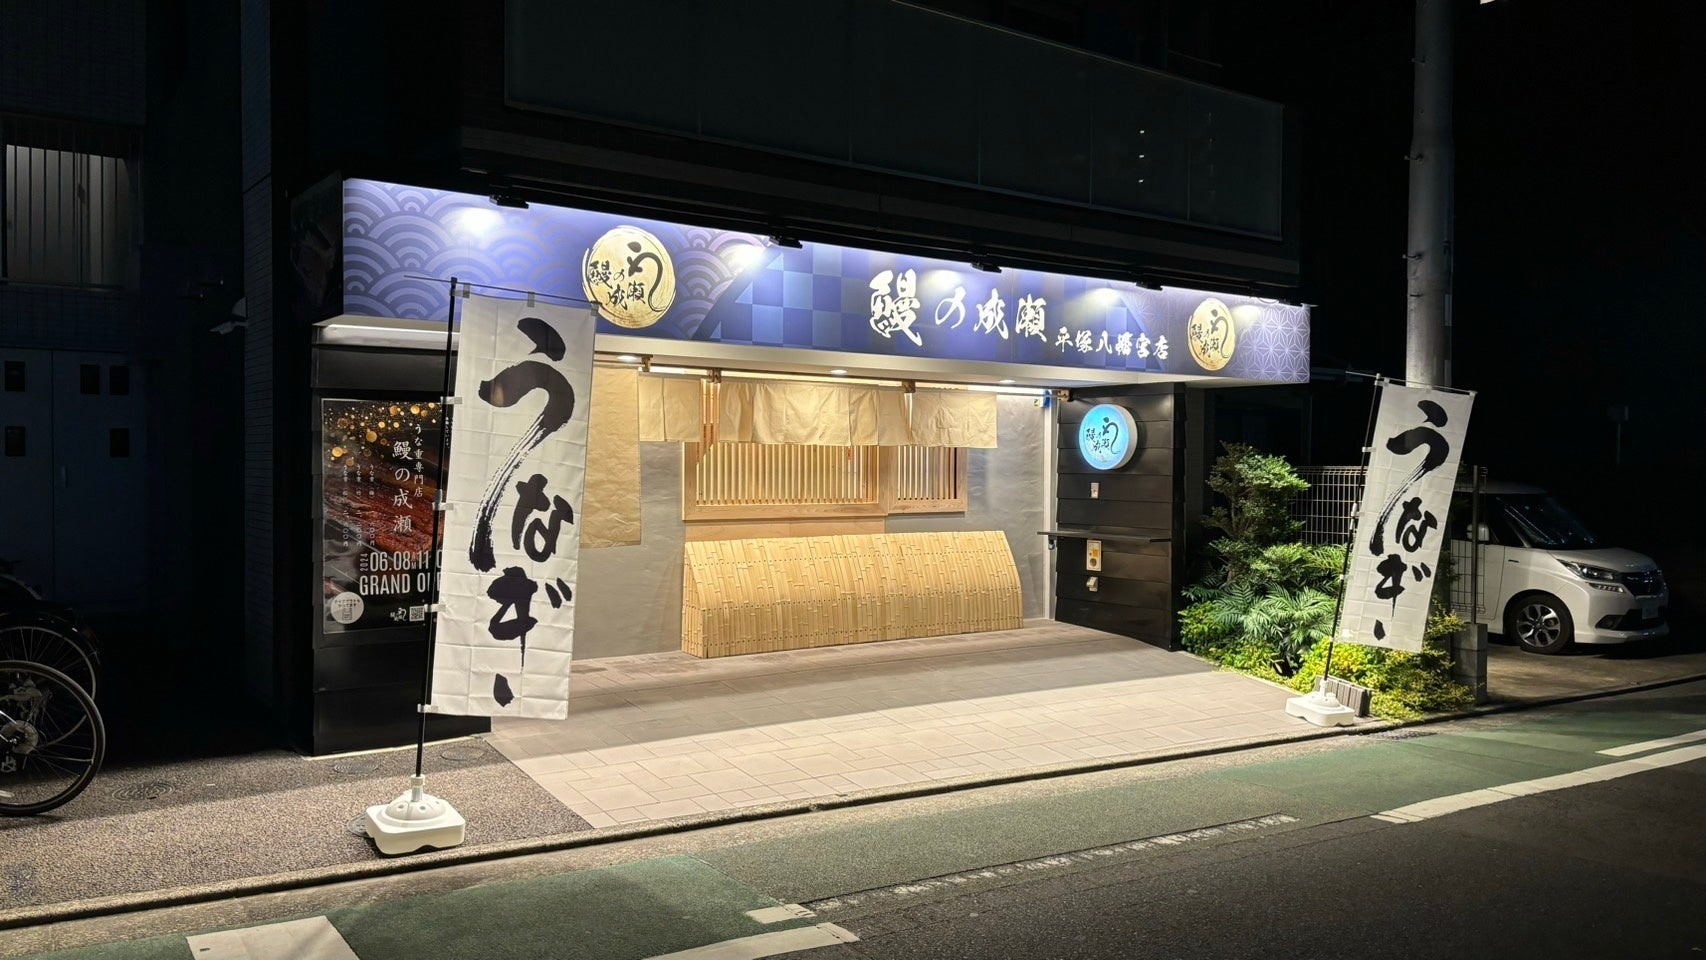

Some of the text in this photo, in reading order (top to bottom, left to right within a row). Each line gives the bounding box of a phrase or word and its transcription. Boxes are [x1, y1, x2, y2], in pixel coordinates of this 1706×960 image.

[869, 268, 1047, 346] 鰻の成瀬
[1055, 326, 1169, 360] 平塚八幡宮店
[392, 440, 413, 533] 鰻の成瀬
[414, 423, 424, 498] うな重専門店
[469, 317, 575, 708] うなぎ
[1369, 399, 1449, 640] うなぎ
[359, 572, 411, 596] GRAND
[360, 553, 369, 572] 2024
[370, 551, 411, 572] 06.08
